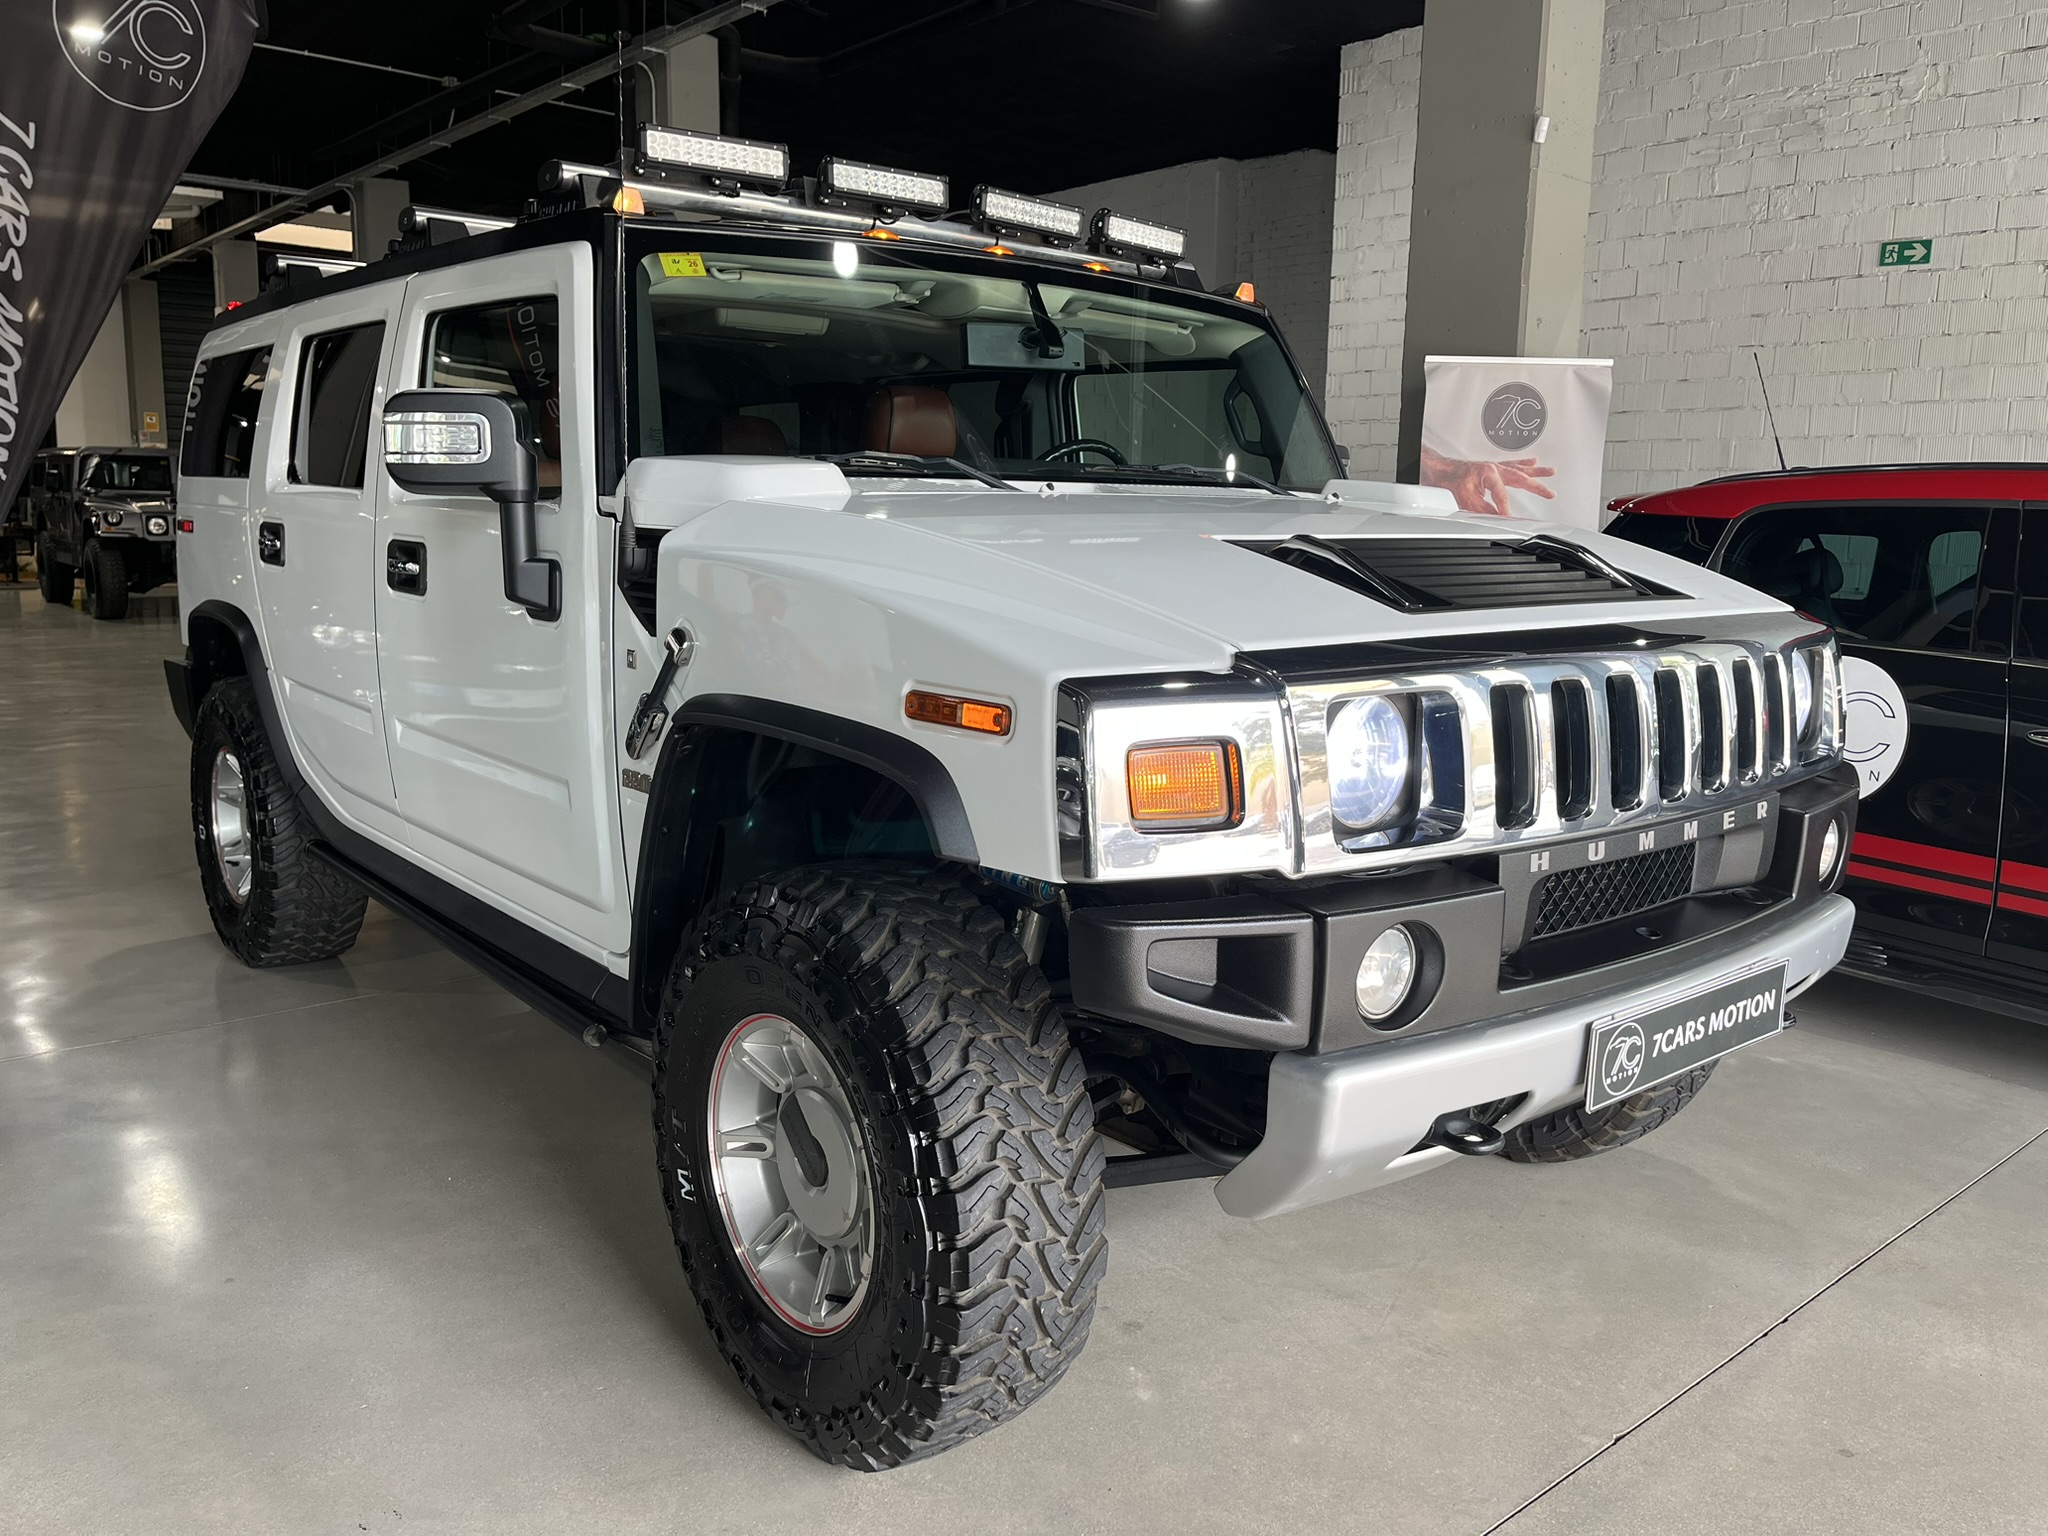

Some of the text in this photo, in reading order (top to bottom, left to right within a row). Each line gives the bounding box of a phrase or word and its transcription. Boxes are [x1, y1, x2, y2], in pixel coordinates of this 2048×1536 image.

[74, 42, 184, 91] MOTION
[688, 260, 699, 268] 26
[0, 293, 24, 481] MOTI
[1490, 394, 1542, 430] 7C
[1529, 801, 1768, 873] HUMMER
[1651, 988, 1776, 1058] 7CARS MOTION
[1606, 1066, 1639, 1085] MOTION
